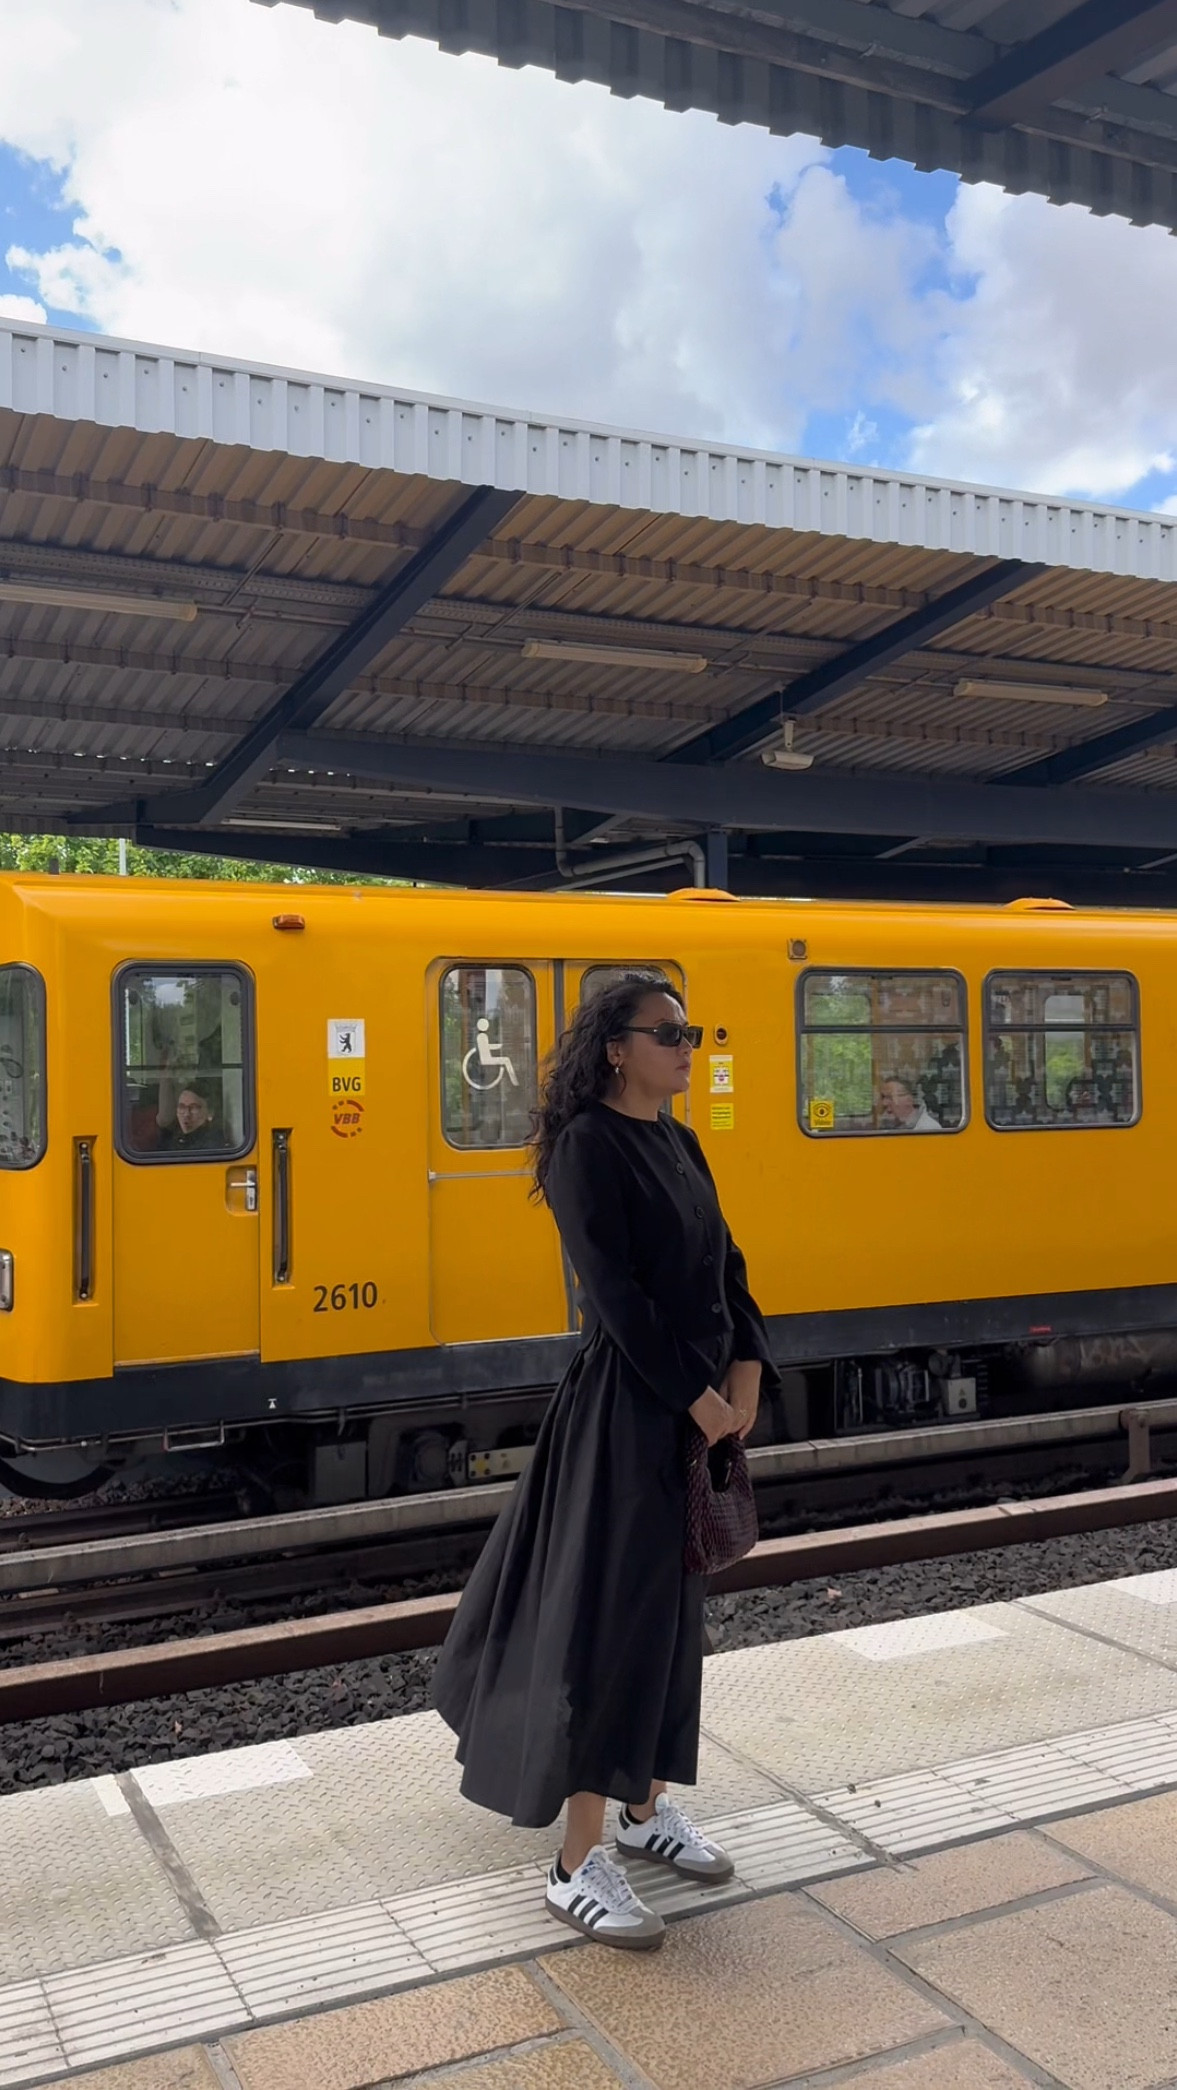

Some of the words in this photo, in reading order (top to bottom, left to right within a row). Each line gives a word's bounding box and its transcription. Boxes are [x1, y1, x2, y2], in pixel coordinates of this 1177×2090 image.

[332, 1077, 362, 1092] BVG
[334, 1112, 361, 1125] VBB
[313, 1281, 378, 1312] 2610
